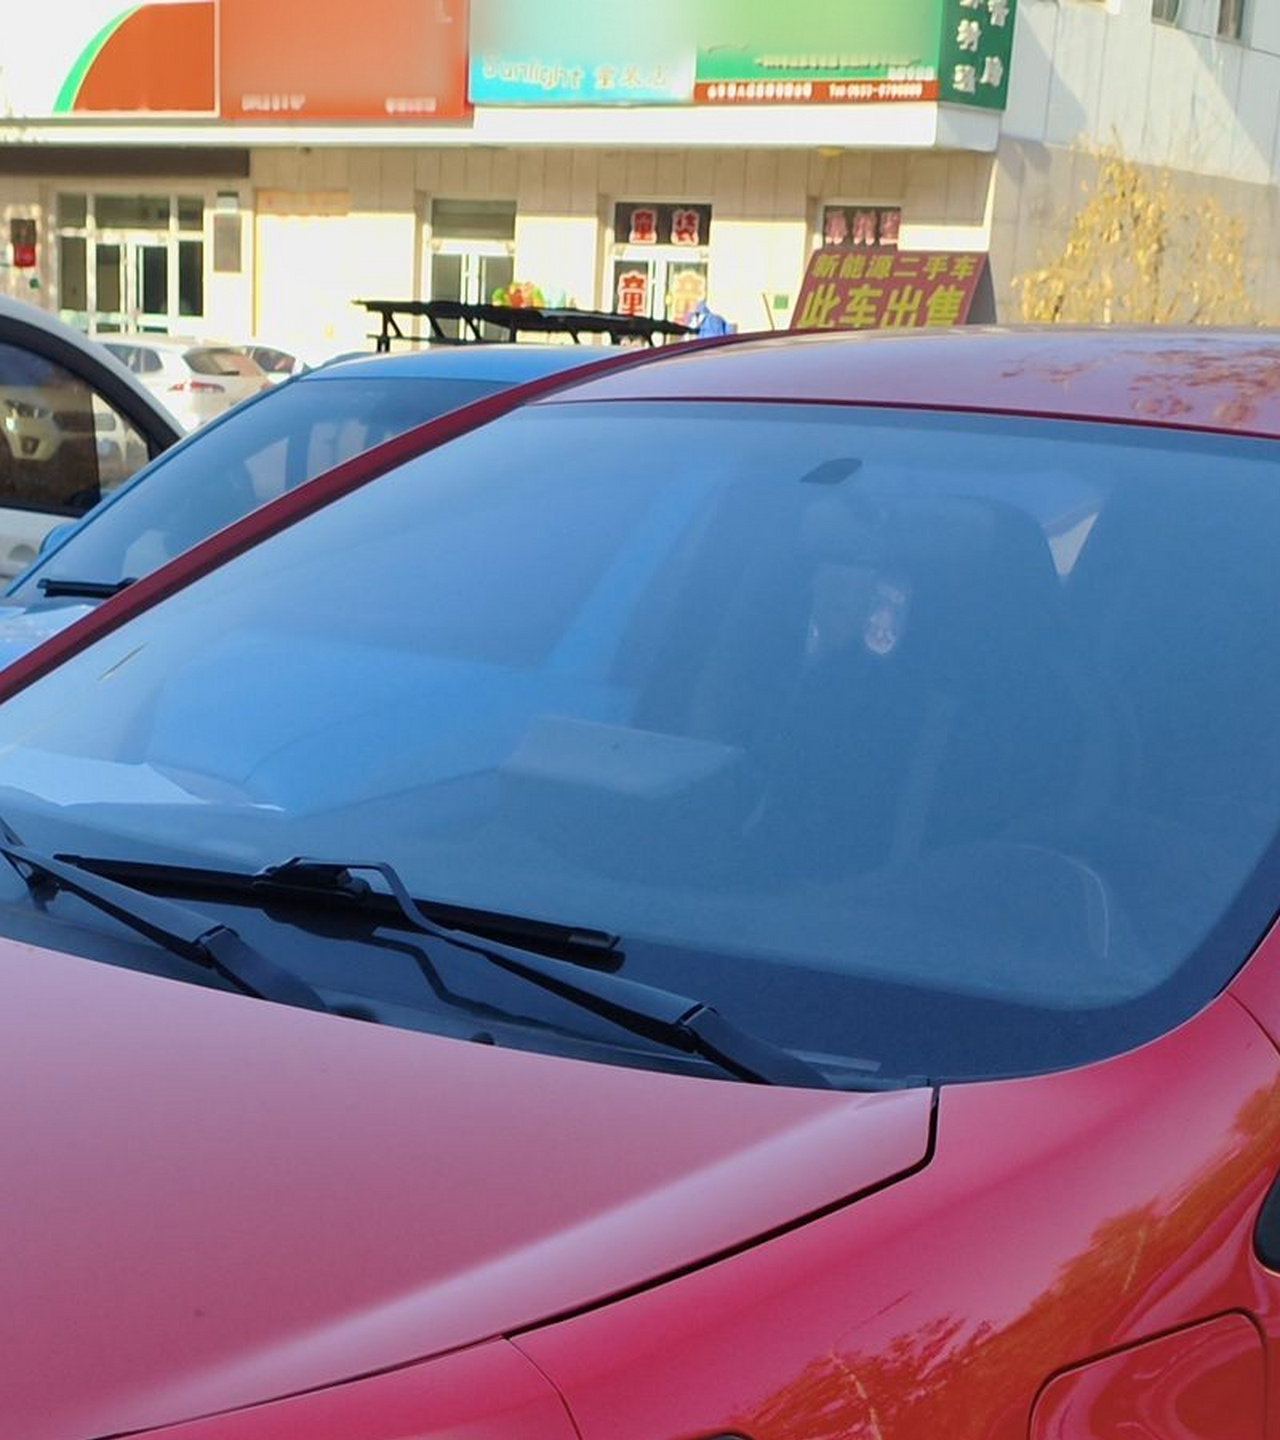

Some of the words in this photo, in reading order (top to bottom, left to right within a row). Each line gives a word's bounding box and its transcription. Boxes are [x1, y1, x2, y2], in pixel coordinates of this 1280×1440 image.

[813, 254, 978, 281] 新能源二手车
[795, 282, 966, 328] 此车出售
